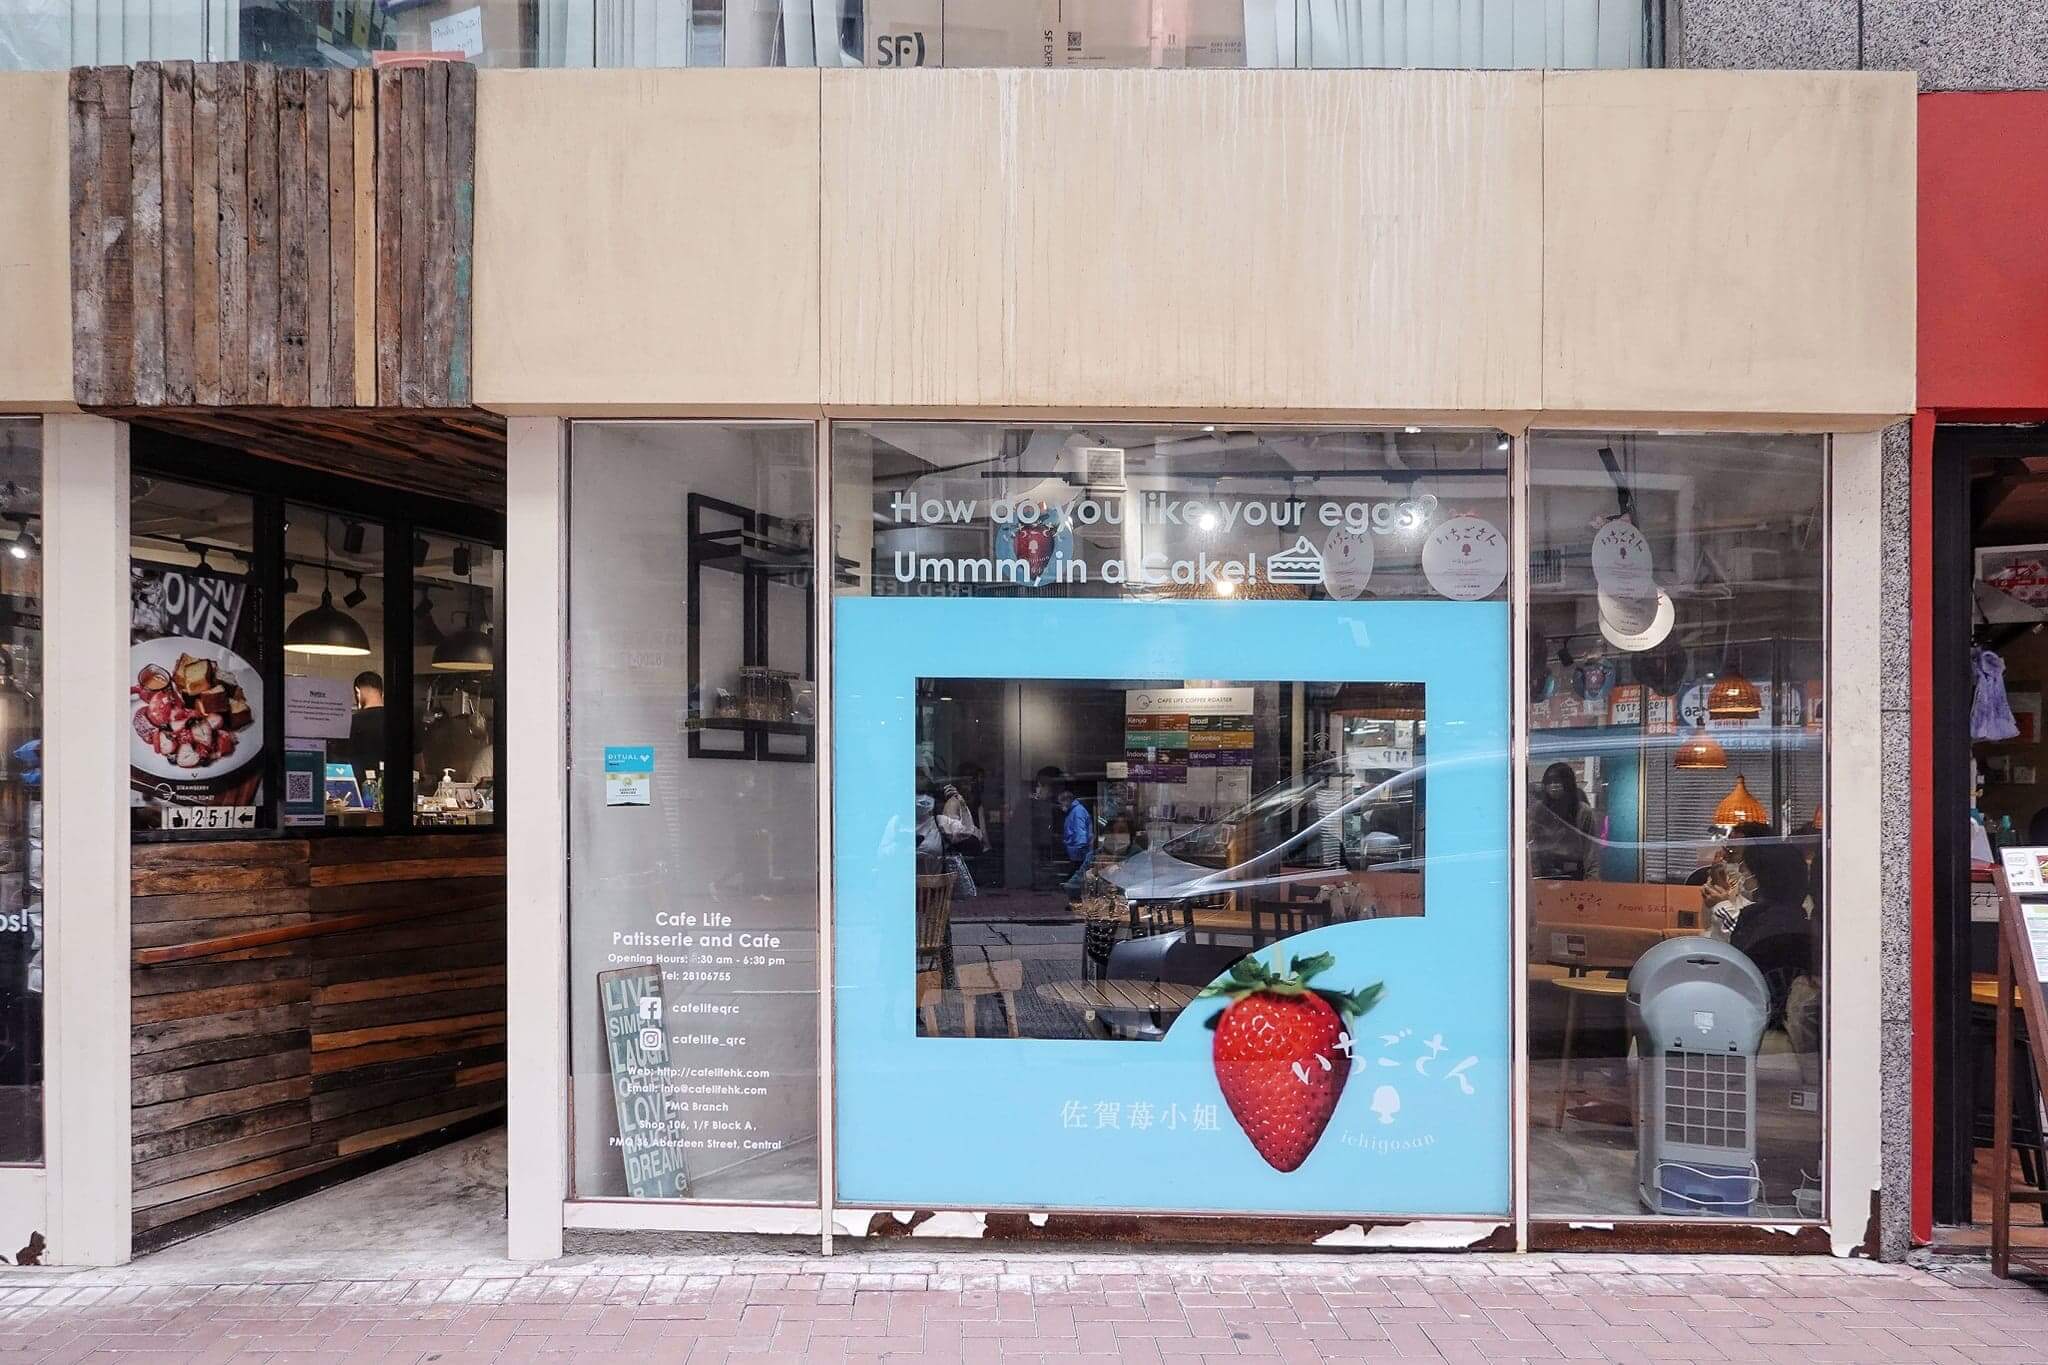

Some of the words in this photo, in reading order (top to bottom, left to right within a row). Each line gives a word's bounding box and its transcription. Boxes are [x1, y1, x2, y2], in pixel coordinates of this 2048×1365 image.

[1043, 29, 1054, 42] SF
[895, 491, 977, 524] How
[991, 492, 1041, 524] do
[1052, 500, 1122, 533] you
[1141, 492, 1204, 525] like
[1219, 500, 1307, 533] your
[894, 551, 1041, 587] Ummm,
[1055, 551, 1087, 584] in
[1101, 557, 1126, 584] a
[1141, 551, 1257, 586] Cake!
[655, 912, 697, 927] Cafe
[703, 912, 732, 927] Life
[612, 931, 693, 947] Patisserie
[699, 933, 733, 948] and
[739, 934, 781, 948] Cafe
[607, 953, 653, 966] Opening
[656, 954, 689, 964] Hours:
[715, 957, 733, 965] am
[743, 956, 766, 966] 6:30
[767, 958, 786, 967] pm
[661, 971, 679, 981] Tel:
[682, 971, 731, 982] 28106755
[605, 976, 660, 1012] LIVE
[672, 1002, 740, 1016] cafelifeqrc
[672, 1034, 746, 1047] cafelife_qrc
[1292, 1028, 1479, 1095] いちごさん
[657, 1067, 770, 1079] http://cafelifehk.com
[622, 1093, 676, 1132] LOVE
[665, 1102, 690, 1112] PMQ
[693, 1102, 729, 1112] Branch
[639, 1120, 665, 1131] Shop
[668, 1121, 690, 1131] 106,
[693, 1120, 709, 1131] 1/F
[712, 1120, 742, 1131] Block
[609, 1137, 634, 1147] PMQ
[649, 1138, 704, 1148] Aberdeen
[743, 1139, 782, 1150] Central
[1340, 1128, 1437, 1153] ichigosan
[629, 1146, 684, 1185] DREAM
